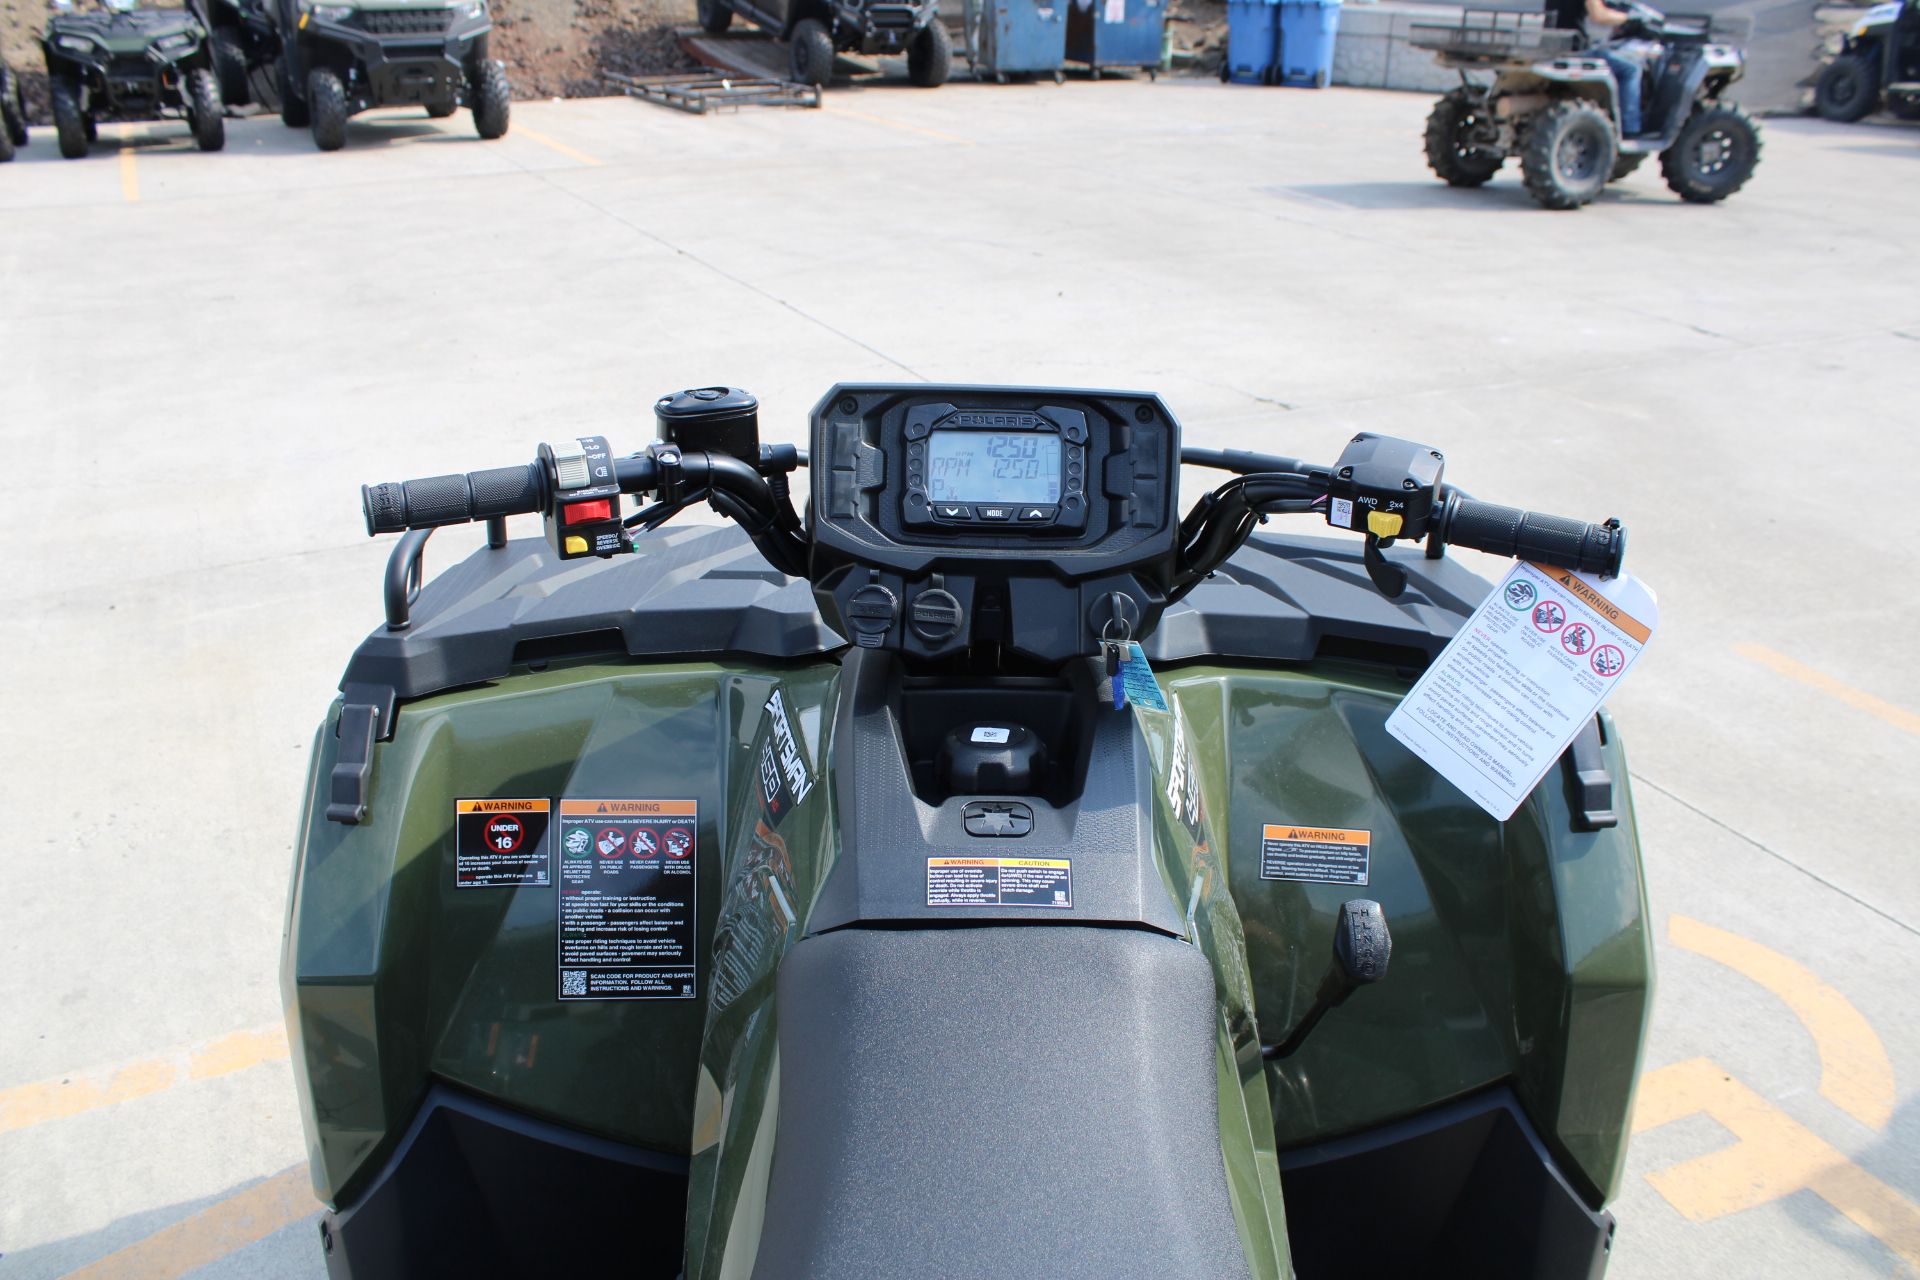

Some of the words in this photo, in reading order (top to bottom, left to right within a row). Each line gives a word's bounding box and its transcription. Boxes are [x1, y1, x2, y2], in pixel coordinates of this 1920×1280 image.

[960, 416, 1033, 426] POLARIS
[987, 436, 1038, 458] 1250
[932, 457, 970, 476] RPM
[993, 459, 1039, 478] 1250
[932, 478, 944, 499] P
[1573, 581, 1619, 620] WARNING
[765, 689, 812, 805] SPORTSMAN
[1415, 706, 1436, 724] FOLLOW
[1435, 722, 1446, 732] ALL
[1444, 729, 1480, 759] INSTRUCTIONS
[1478, 756, 1490, 767] AND
[1489, 764, 1516, 787] WARNINGS
[1426, 707, 1447, 724] LOCATE
[1445, 721, 1457, 732] AND
[1455, 729, 1471, 743] READ
[1469, 740, 1493, 760] OWNER'S
[1491, 757, 1514, 777] MANUAL.
[484, 802, 532, 810] WARNING
[611, 803, 660, 812] WARNING
[496, 837, 512, 848] 16
[1298, 830, 1345, 840] WARNING
